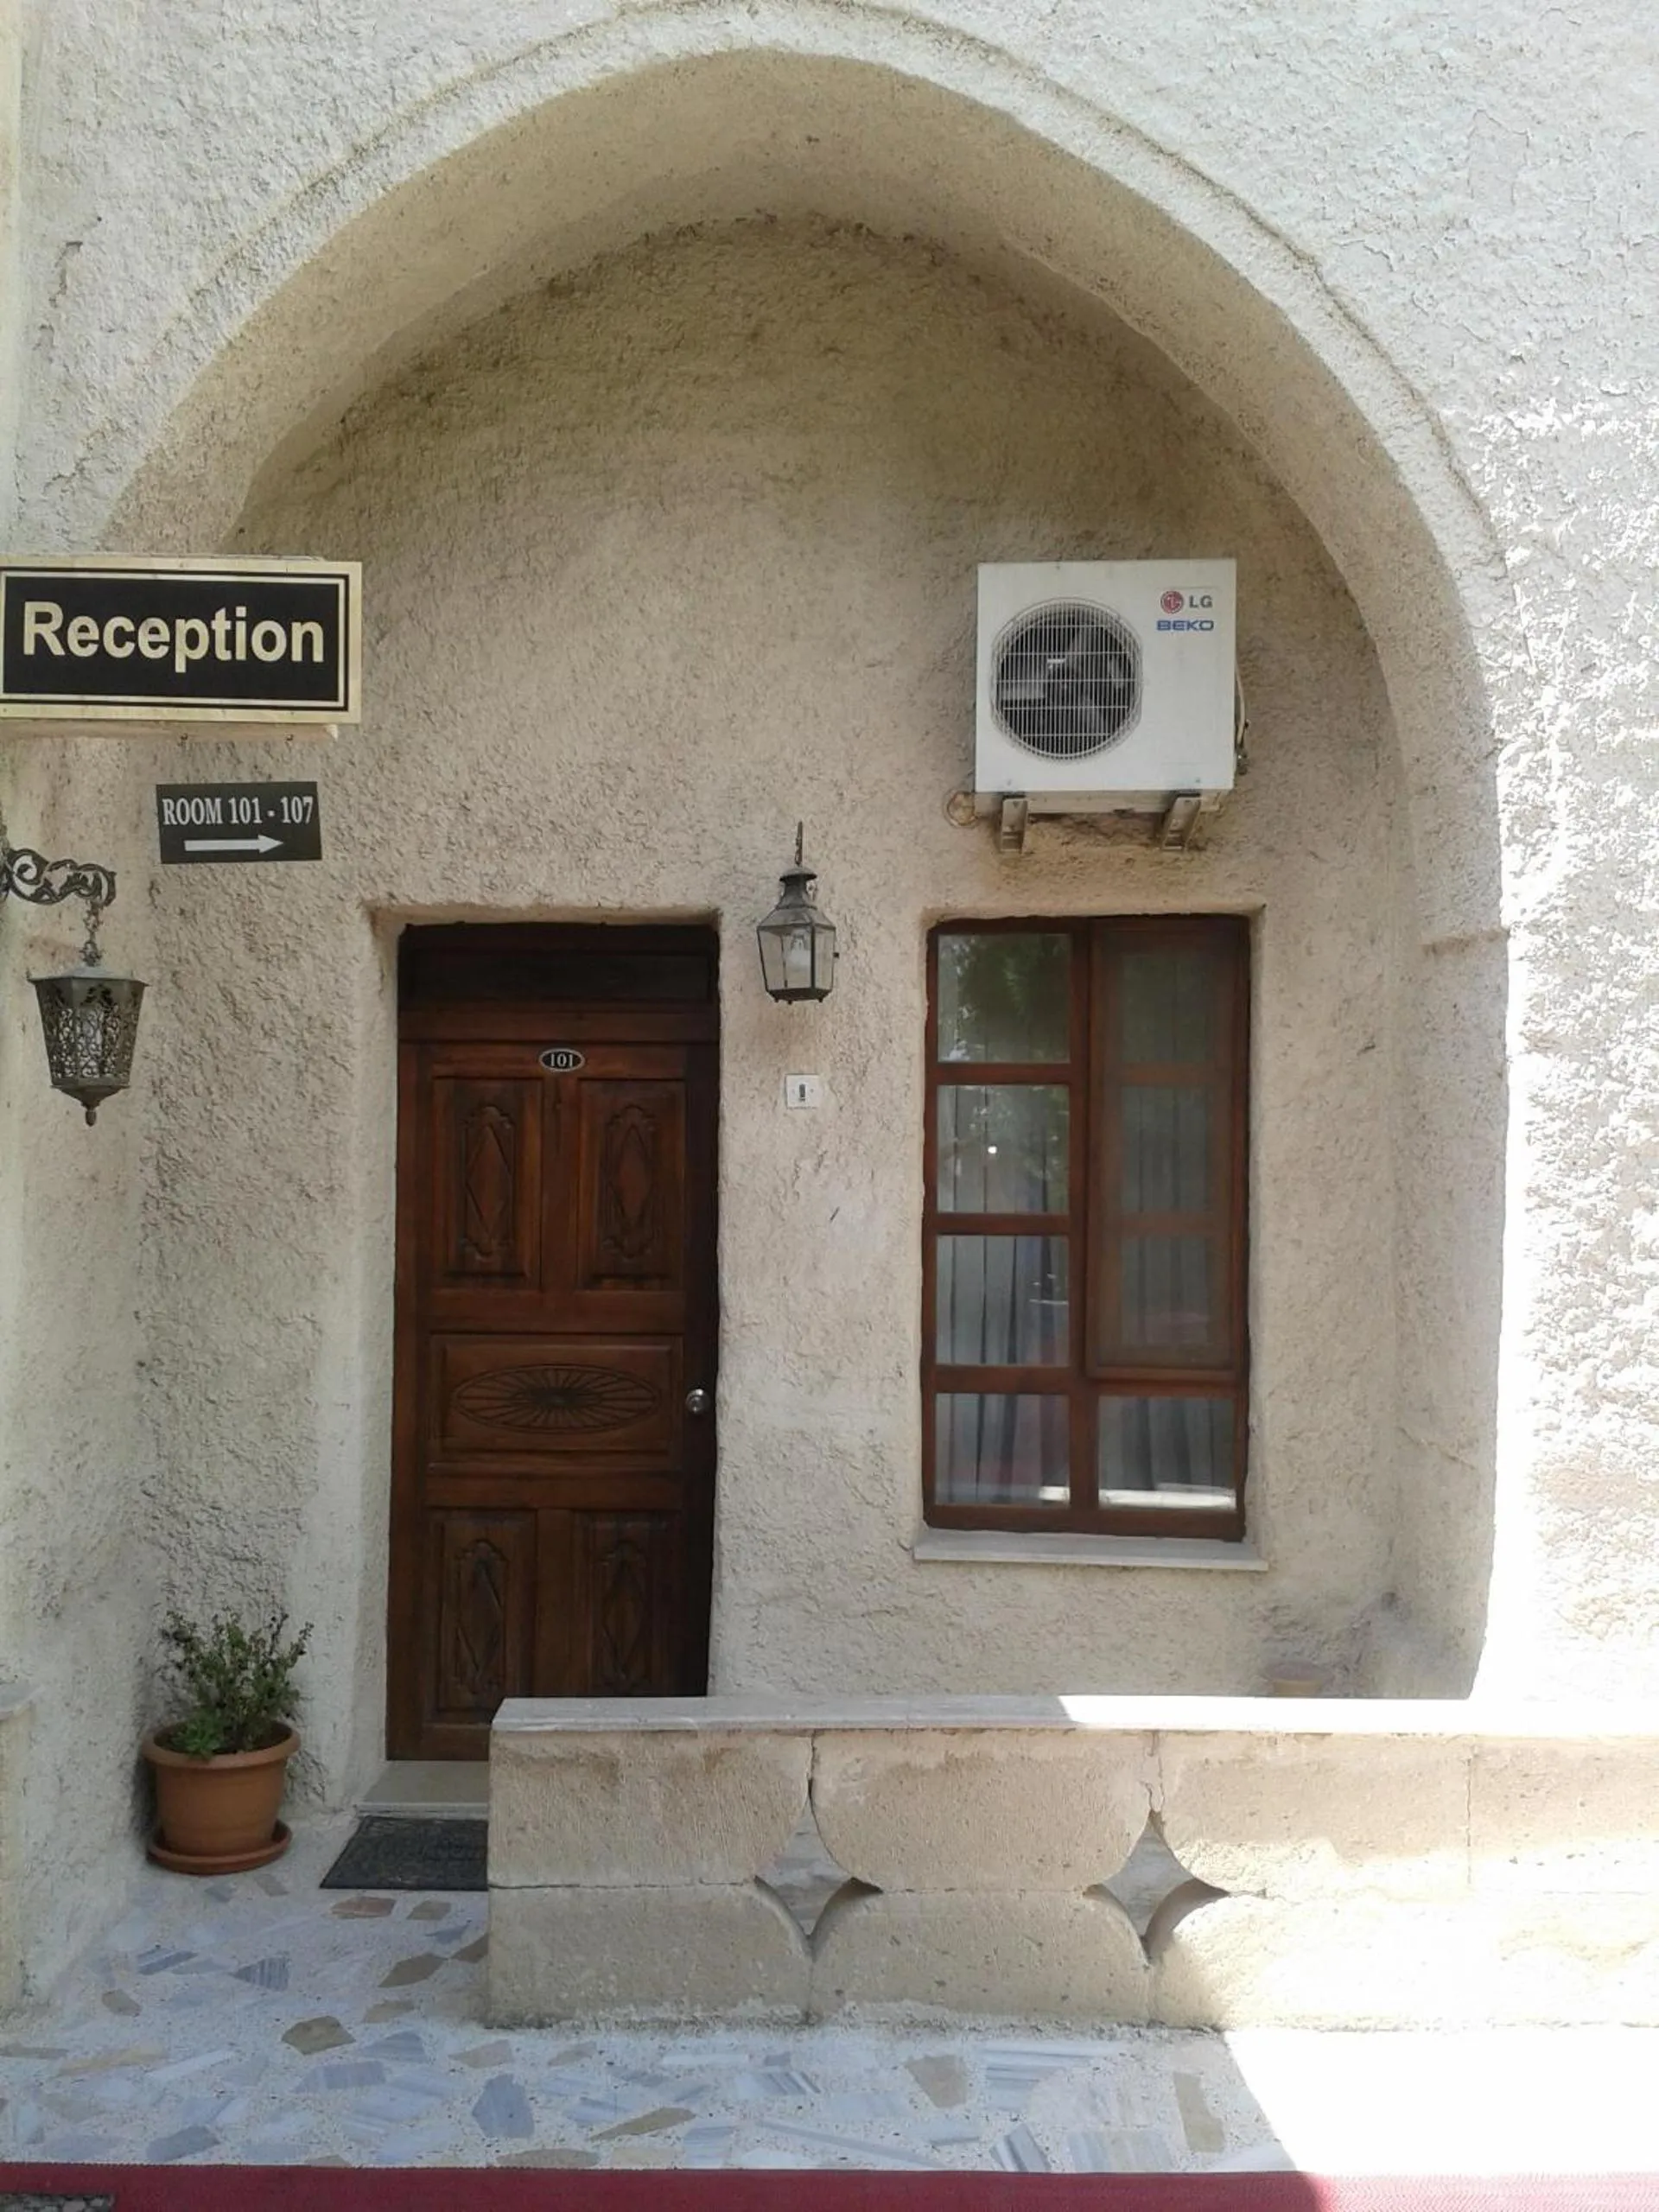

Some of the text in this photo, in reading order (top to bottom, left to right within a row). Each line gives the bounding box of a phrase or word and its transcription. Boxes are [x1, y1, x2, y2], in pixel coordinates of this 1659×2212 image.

[1189, 595, 1213, 608] LG
[1157, 620, 1214, 631] BEKO
[23, 601, 324, 673] Reception
[162, 798, 223, 826] ROOM
[230, 798, 263, 825] 101
[281, 796, 314, 824] 107
[550, 1053, 573, 1067] 101
